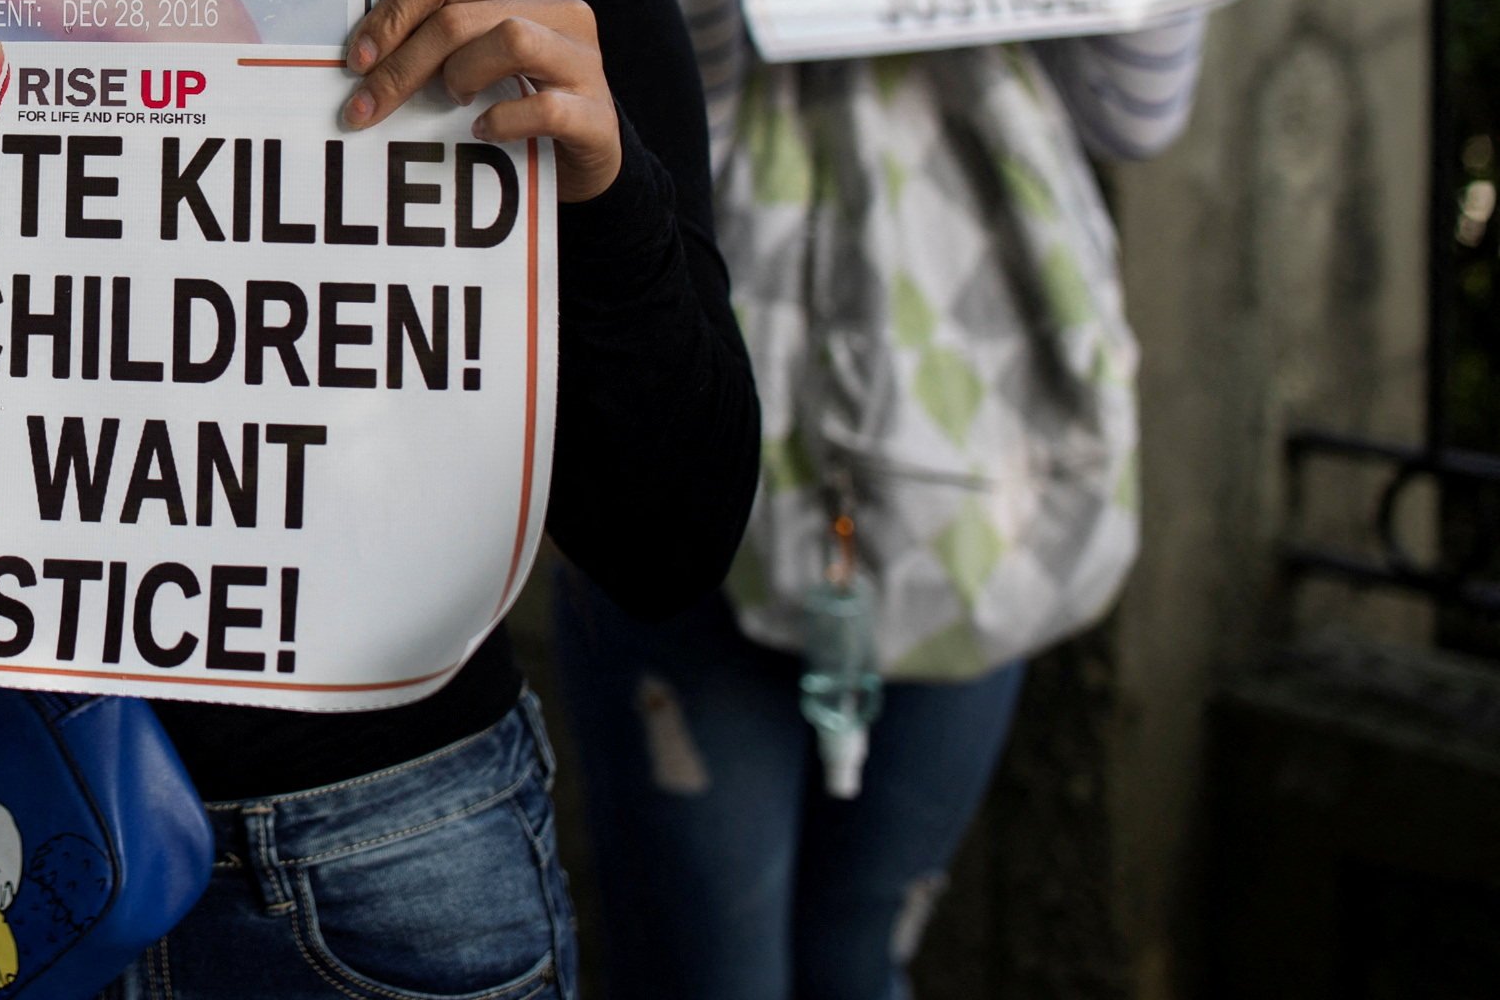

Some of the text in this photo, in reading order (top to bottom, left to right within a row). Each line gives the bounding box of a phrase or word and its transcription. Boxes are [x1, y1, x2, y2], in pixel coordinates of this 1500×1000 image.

[62, 0, 108, 28] DEC
[18, 67, 207, 109] RISE UP
[17, 110, 207, 126] FOR LIFE AND FOR RIGHTS!
[160, 136, 520, 249] KILLED
[26, 415, 328, 530] WANT
